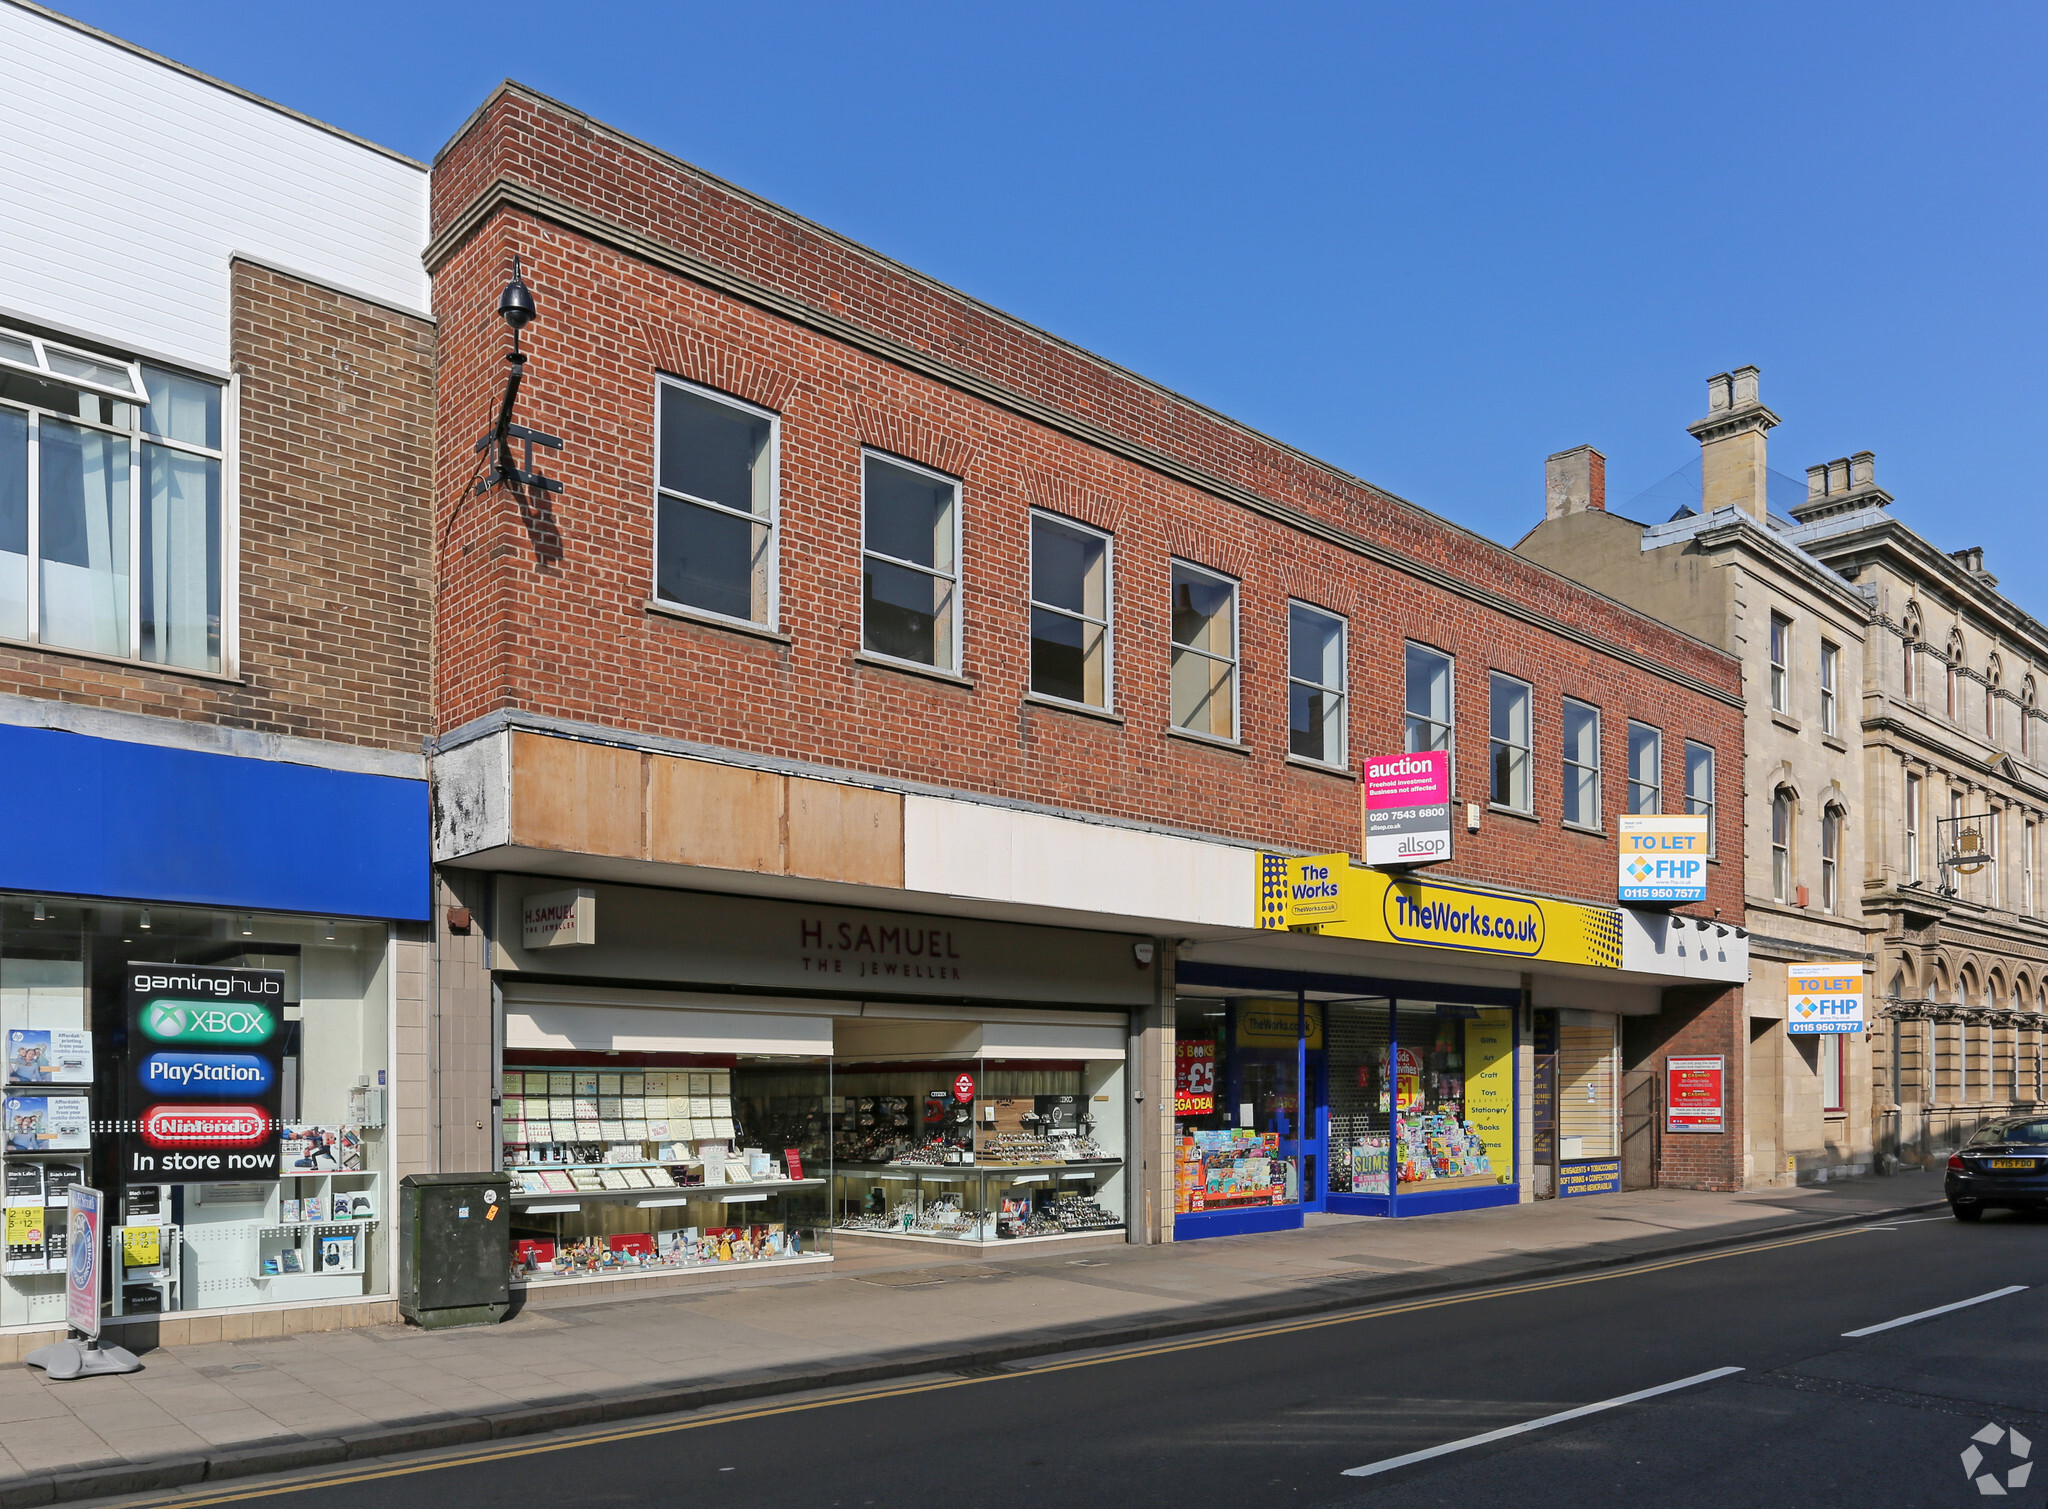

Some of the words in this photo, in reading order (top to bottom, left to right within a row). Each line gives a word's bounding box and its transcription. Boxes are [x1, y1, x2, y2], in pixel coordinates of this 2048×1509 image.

[1369, 757, 1432, 778] auction
[1370, 780, 1396, 788] Freehold
[1398, 777, 1432, 785] investment
[1370, 788, 1398, 796] Business
[1370, 812, 1388, 822] 020
[1392, 810, 1416, 820] 7543
[1419, 808, 1444, 818] 6800
[1370, 823, 1402, 831] allsop.co.uk
[1398, 836, 1445, 854] allsop
[1630, 836, 1656, 850] TO
[1661, 836, 1696, 850] LET
[1301, 864, 1328, 881] The
[1656, 860, 1700, 878] FHP
[1292, 881, 1338, 900] Works
[1624, 889, 1649, 898] 0115
[1651, 889, 1672, 898] 950
[1674, 889, 1700, 898] 7577
[525, 905, 575, 924] H.SAMUEL
[1294, 904, 1336, 913] TheWorks.co.uk
[1396, 896, 1537, 942] TheWorks.co.uk
[542, 922, 574, 933] JEWELLER
[802, 919, 960, 959] H.SAMUEL
[802, 958, 842, 973] THE
[860, 962, 960, 980] JEWELLER
[134, 974, 280, 996] gaminghub
[1798, 980, 1820, 990] TO
[1824, 979, 1854, 990] LET
[1820, 1000, 1857, 1014] FHP
[190, 1010, 265, 1034] XBOX
[1249, 1018, 1310, 1032] TheWorks.co.k
[1188, 1062, 1214, 1093] £5
[161, 1119, 252, 1133] Nintendo
[134, 1153, 154, 1171] In
[162, 1154, 220, 1170] store
[228, 1154, 275, 1169] now
[1354, 1155, 1389, 1173] SLIME
[1561, 1166, 1586, 1175] NEWSAGENTS
[1590, 1163, 1618, 1172] TOBACCONISTS
[1560, 1177, 1570, 1185] SOFT
[1568, 1185, 1586, 1194] SPORTING
